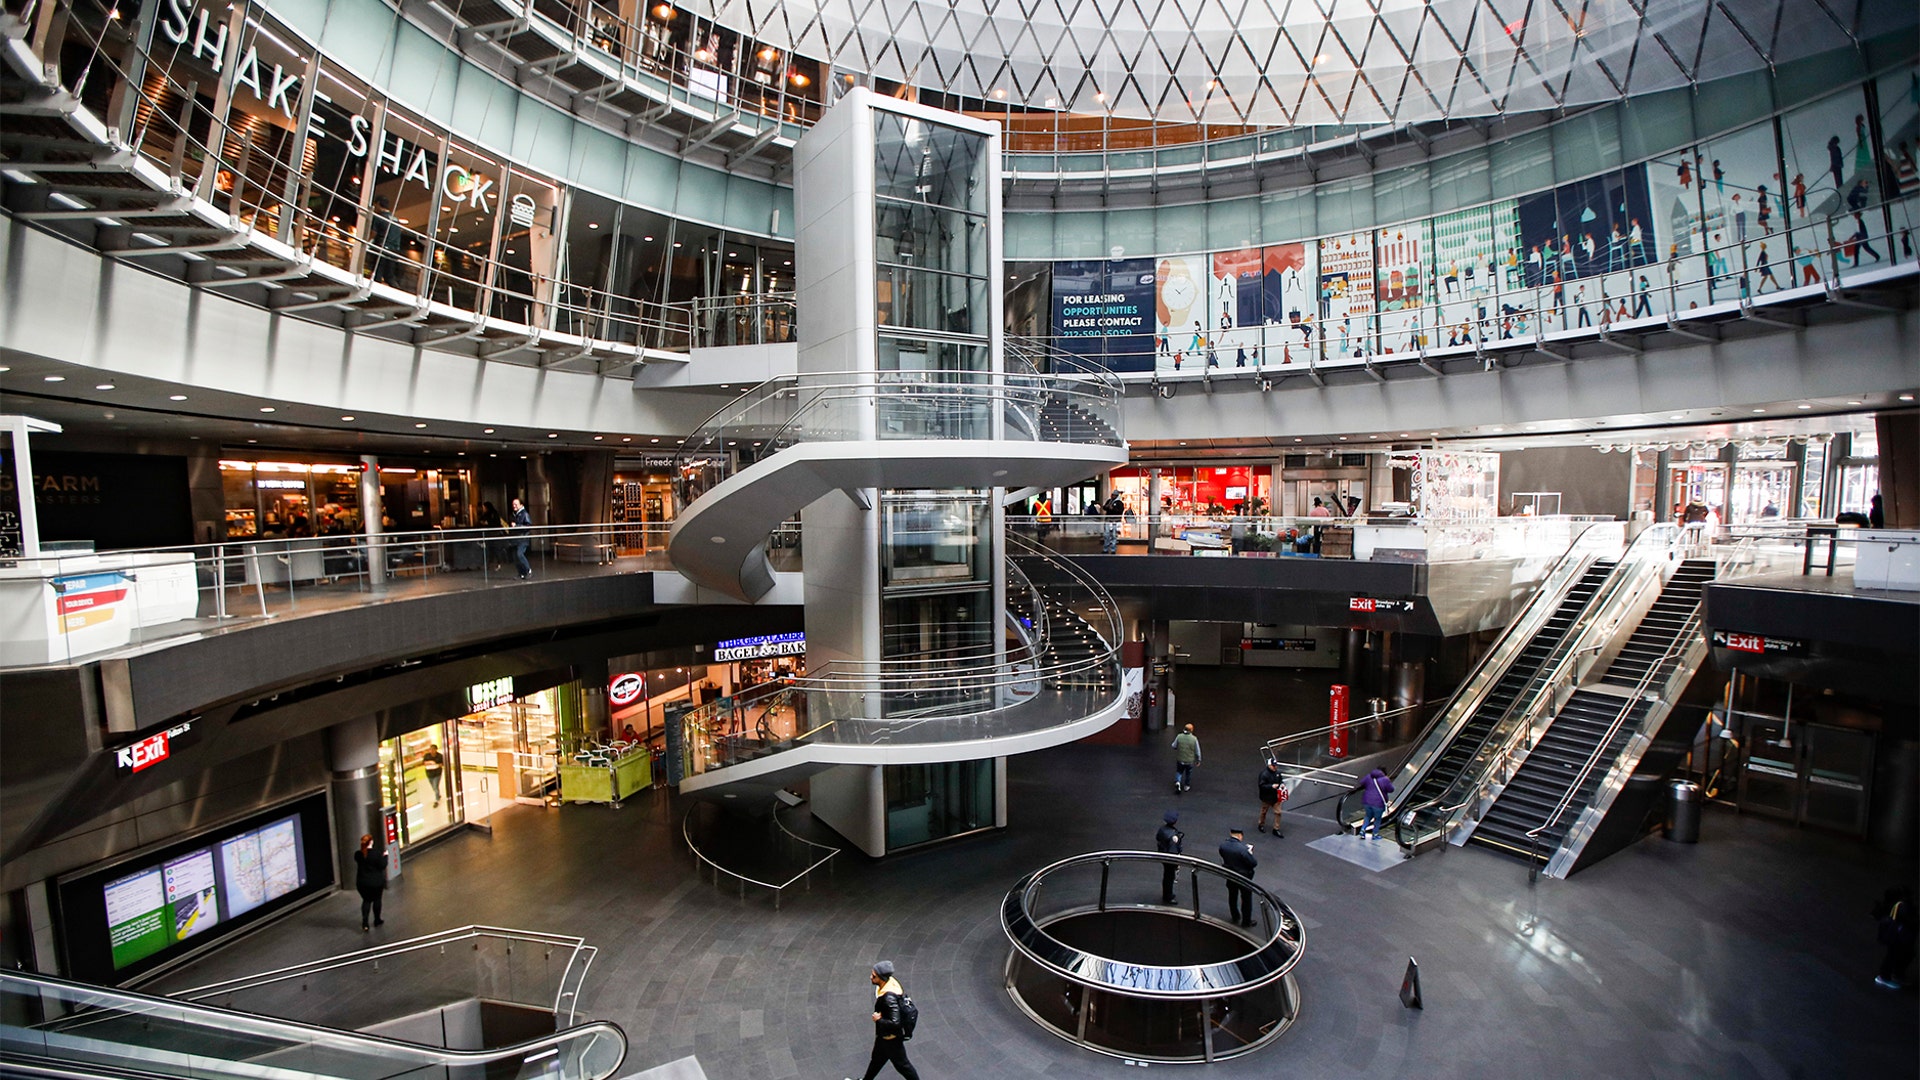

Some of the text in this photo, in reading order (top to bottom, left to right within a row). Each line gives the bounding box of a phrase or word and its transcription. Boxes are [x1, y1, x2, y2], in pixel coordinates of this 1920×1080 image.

[162, 0, 494, 214] SHAKE SHACK
[1063, 293, 1126, 305] FOR LEASING
[1063, 305, 1138, 316] OPPORTUNITIES
[1063, 317, 1143, 328] PLEASE CONTACT
[1349, 597, 1373, 610] Exit
[1726, 633, 1760, 650] Exit
[717, 646, 759, 661] BAGEL
[132, 735, 166, 768] Exit
[183, 723, 191, 732] St
